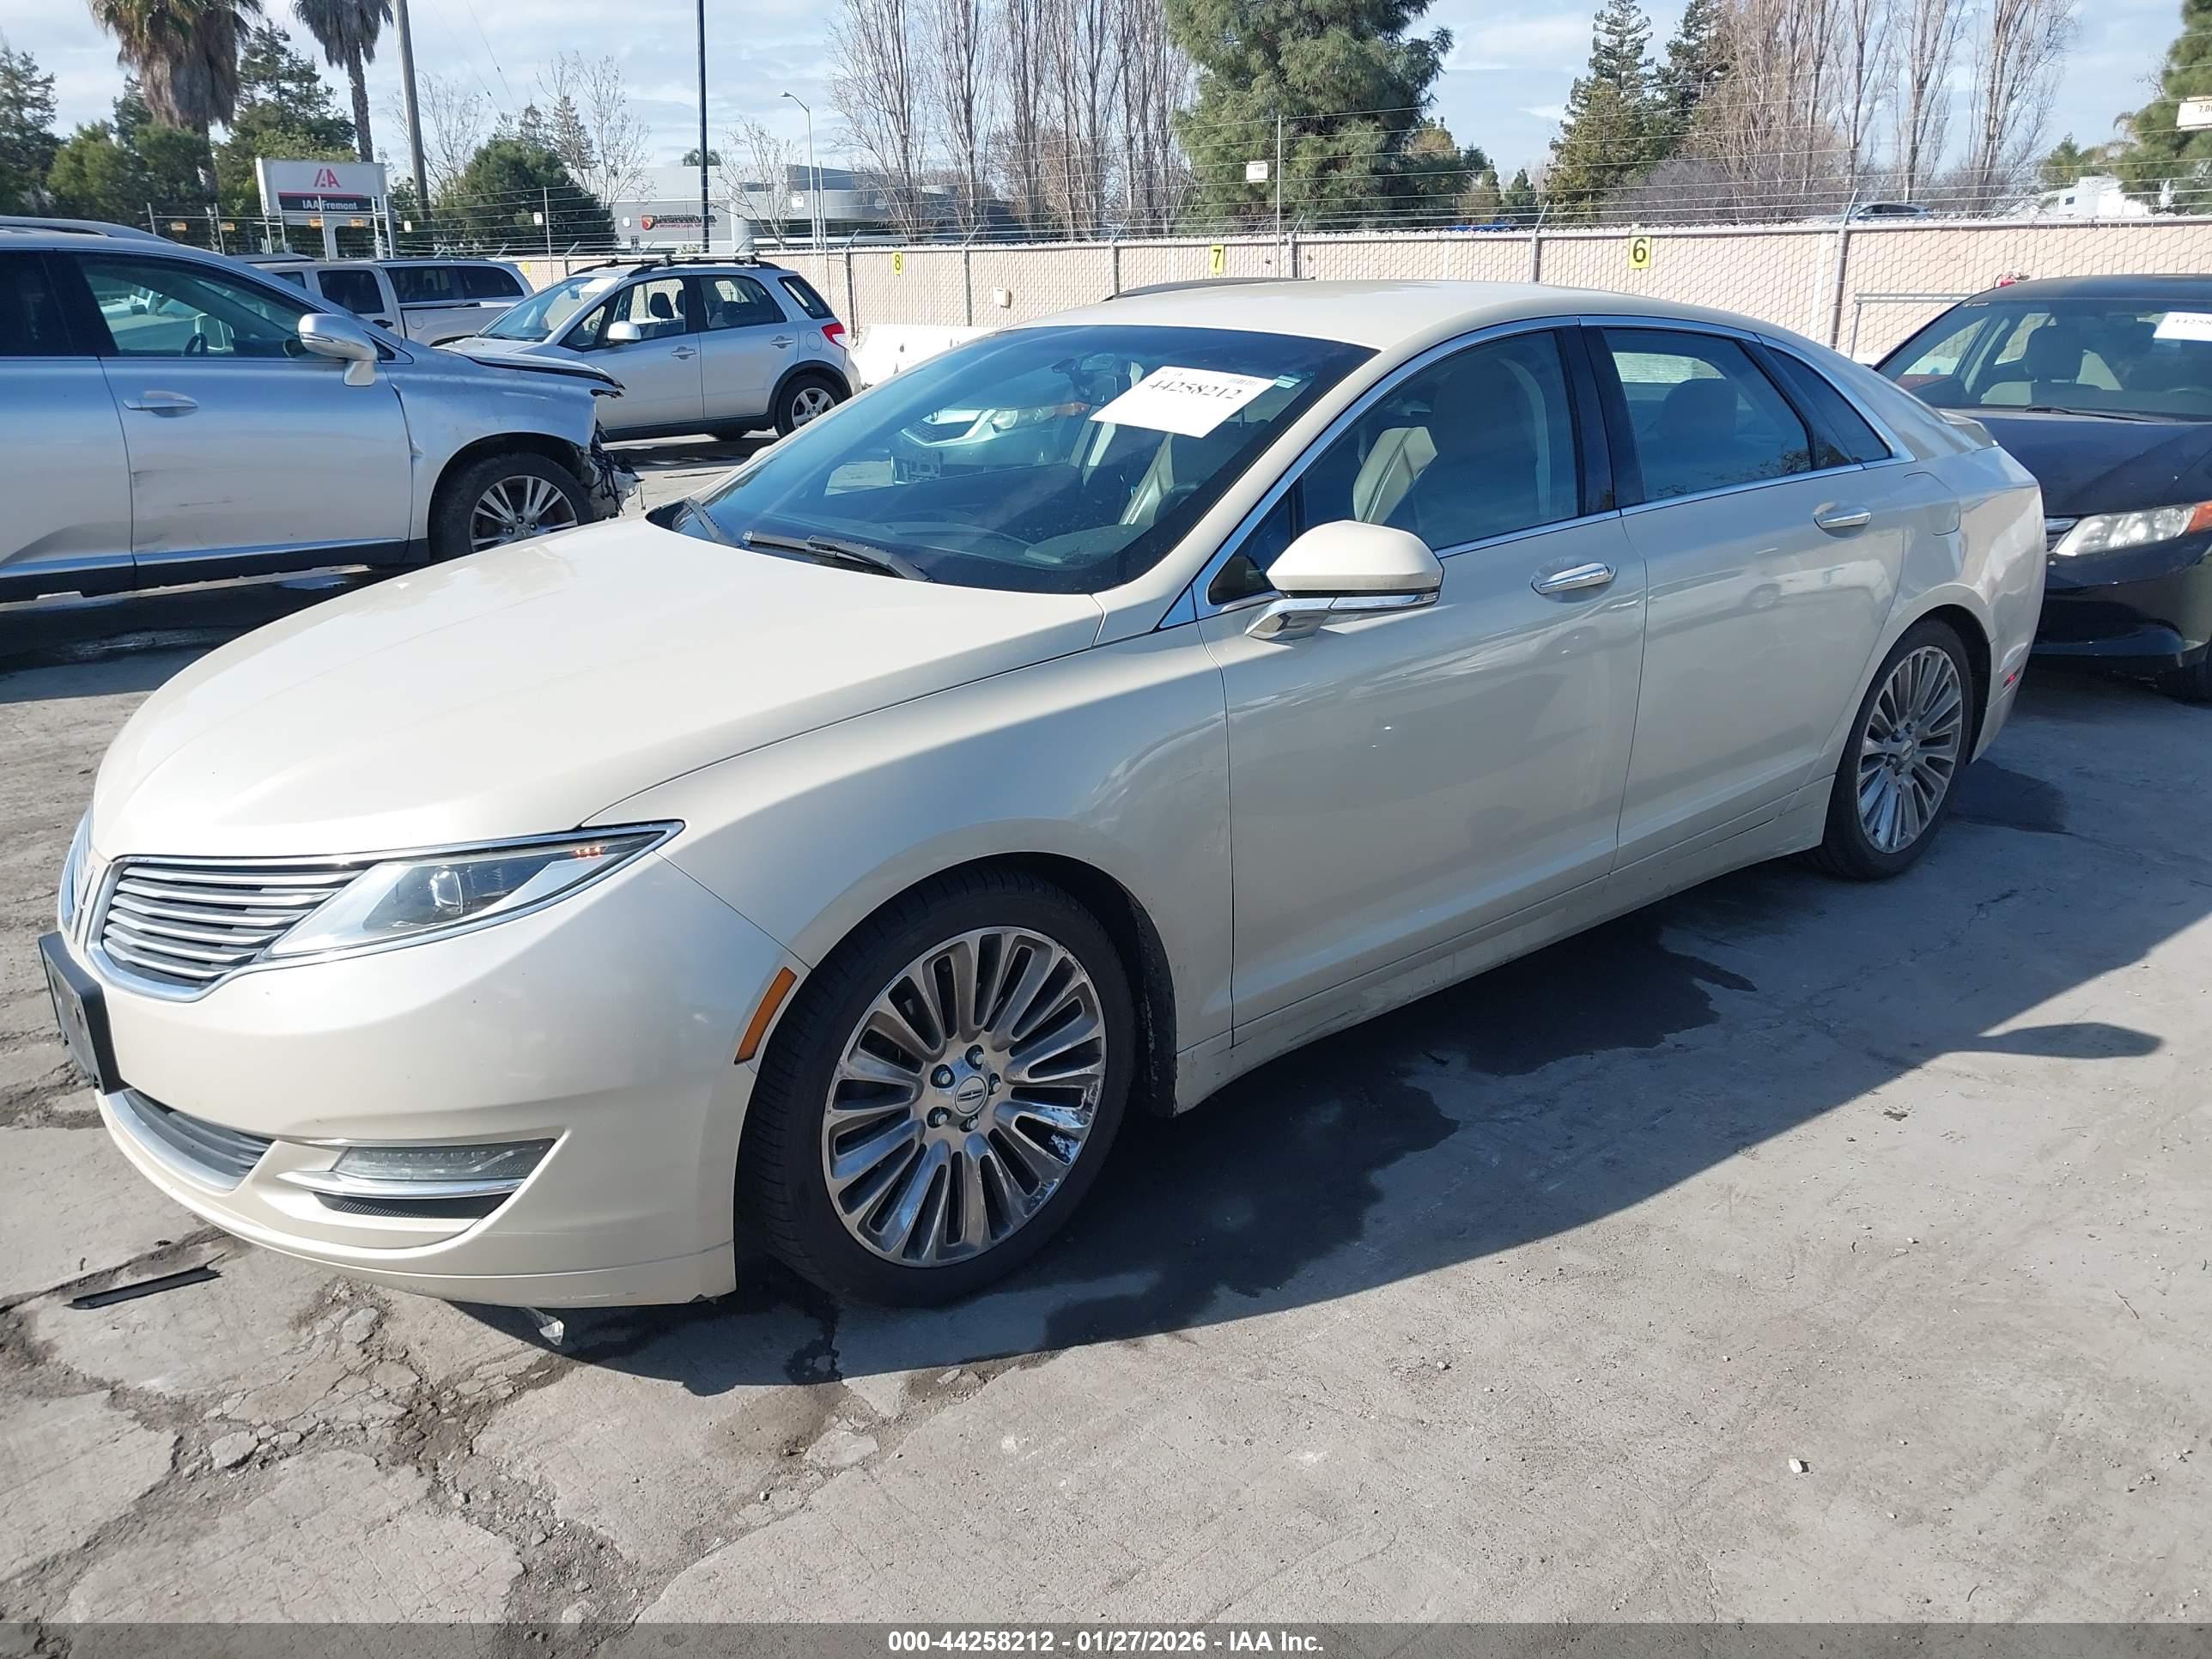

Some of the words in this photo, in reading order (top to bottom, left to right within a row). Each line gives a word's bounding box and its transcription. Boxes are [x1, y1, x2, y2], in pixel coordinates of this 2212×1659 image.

[2198, 104, 2212, 114] 7,0
[302, 200, 319, 210] IAA
[322, 200, 358, 210] Fremont
[1212, 248, 1222, 269] 7
[1632, 237, 1647, 263] 6
[894, 254, 902, 270] 8
[1149, 380, 1243, 399] 44258212
